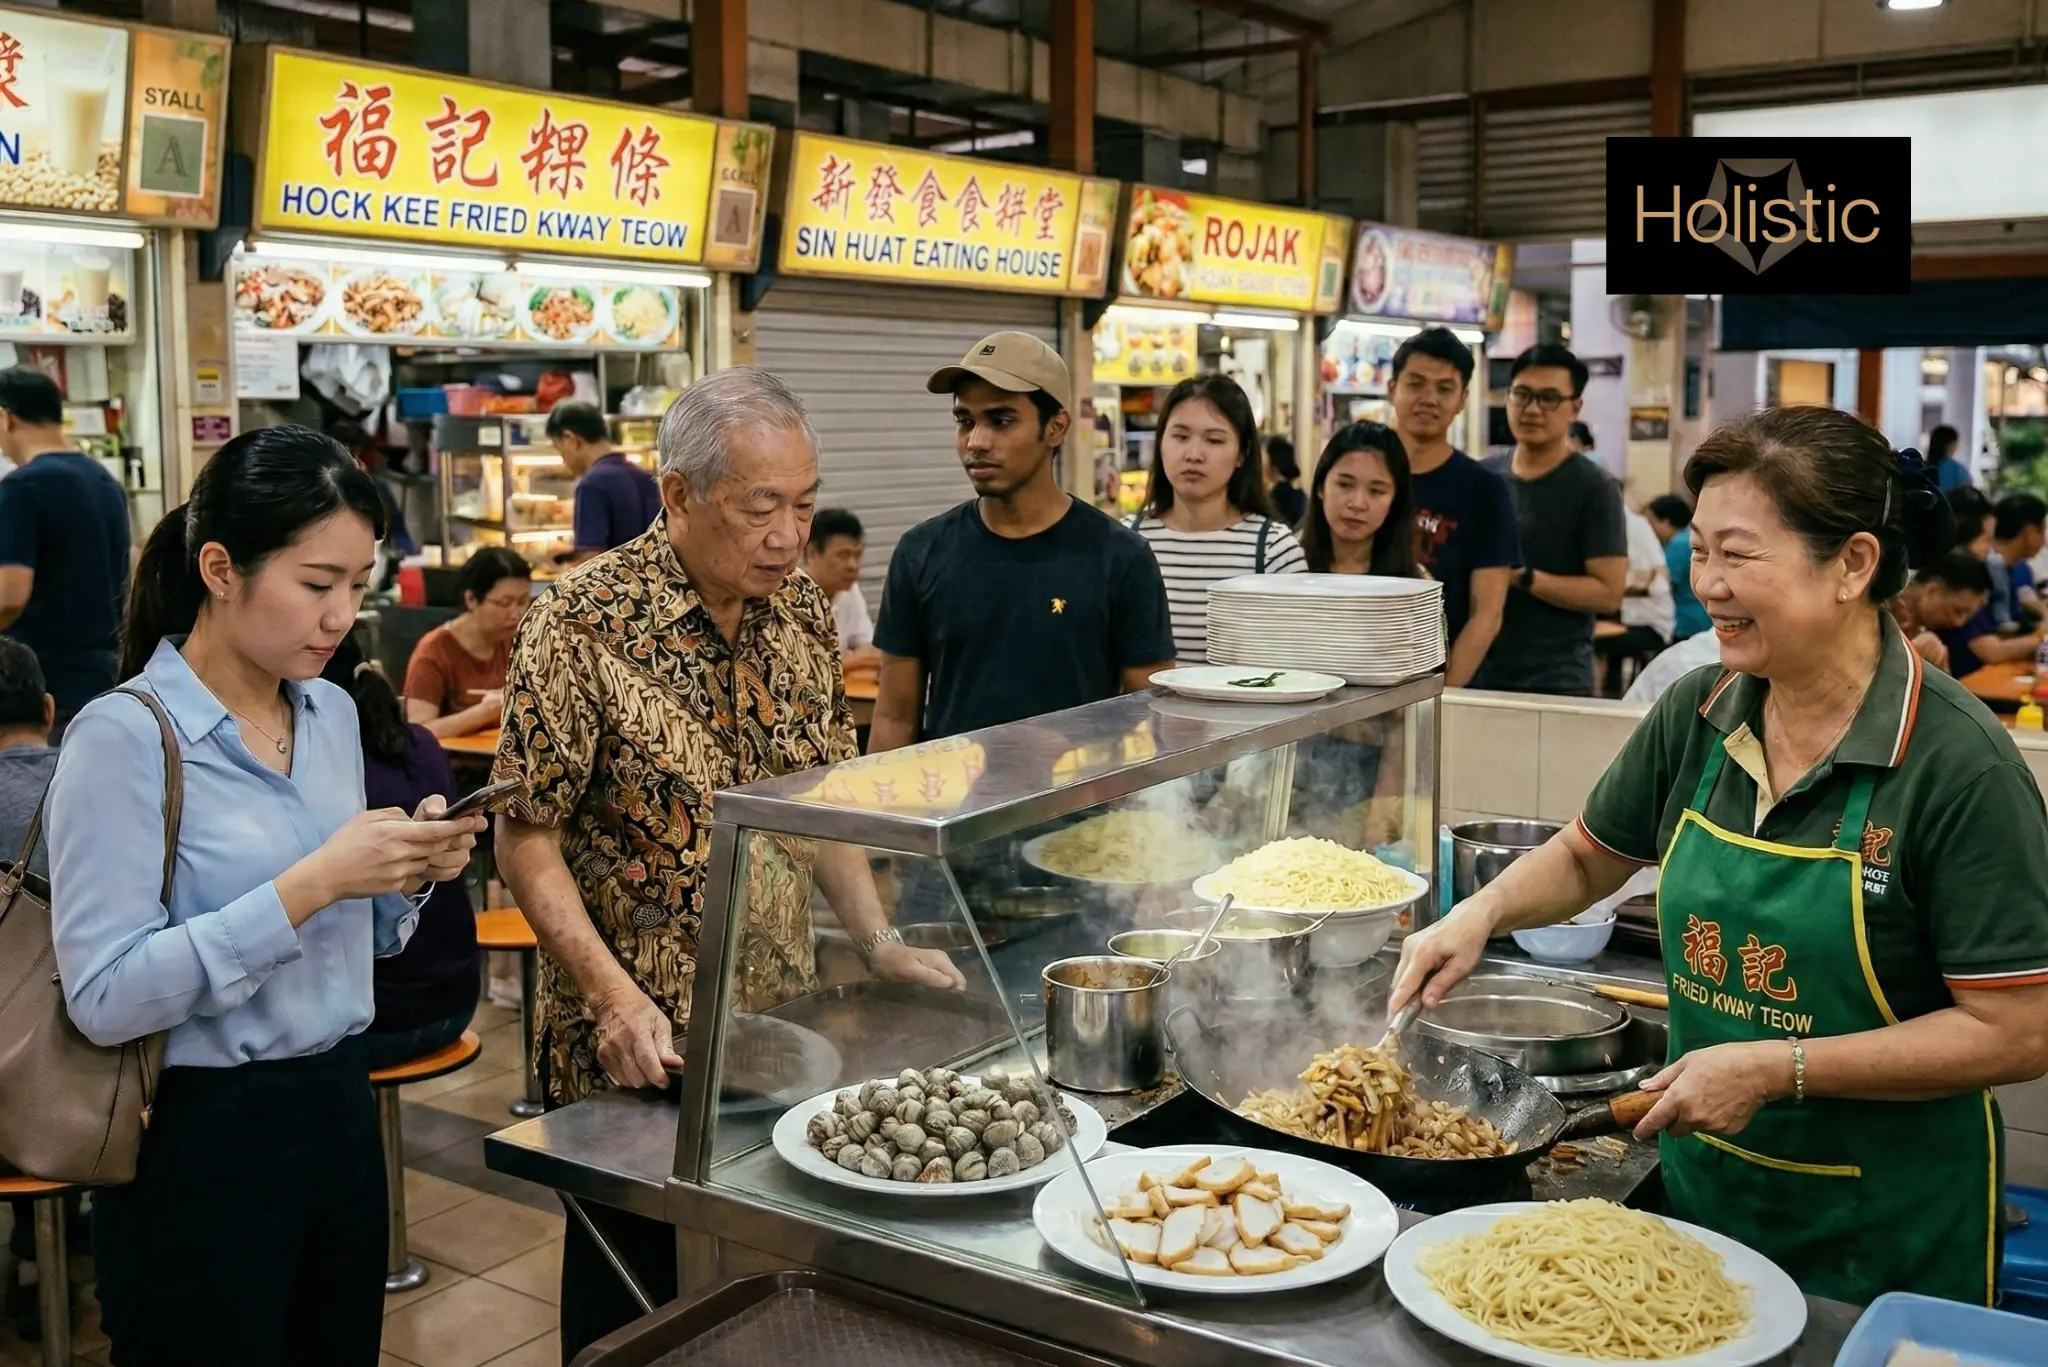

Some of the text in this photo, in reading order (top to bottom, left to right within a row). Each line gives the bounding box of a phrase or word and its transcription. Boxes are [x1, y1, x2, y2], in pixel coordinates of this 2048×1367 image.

[145, 87, 205, 111] STALL
[156, 136, 189, 177] A
[319, 80, 671, 208] 福記粿條
[282, 184, 688, 249] HOCK KEE FRIED KWAY TEOW
[1204, 216, 1301, 265] ROJAK
[796, 226, 1062, 278] SIN HUAT EATING HOUSE
[1681, 913, 1797, 1001] 福記
[1672, 973, 1813, 1034] FRIED KWAY TEOW
